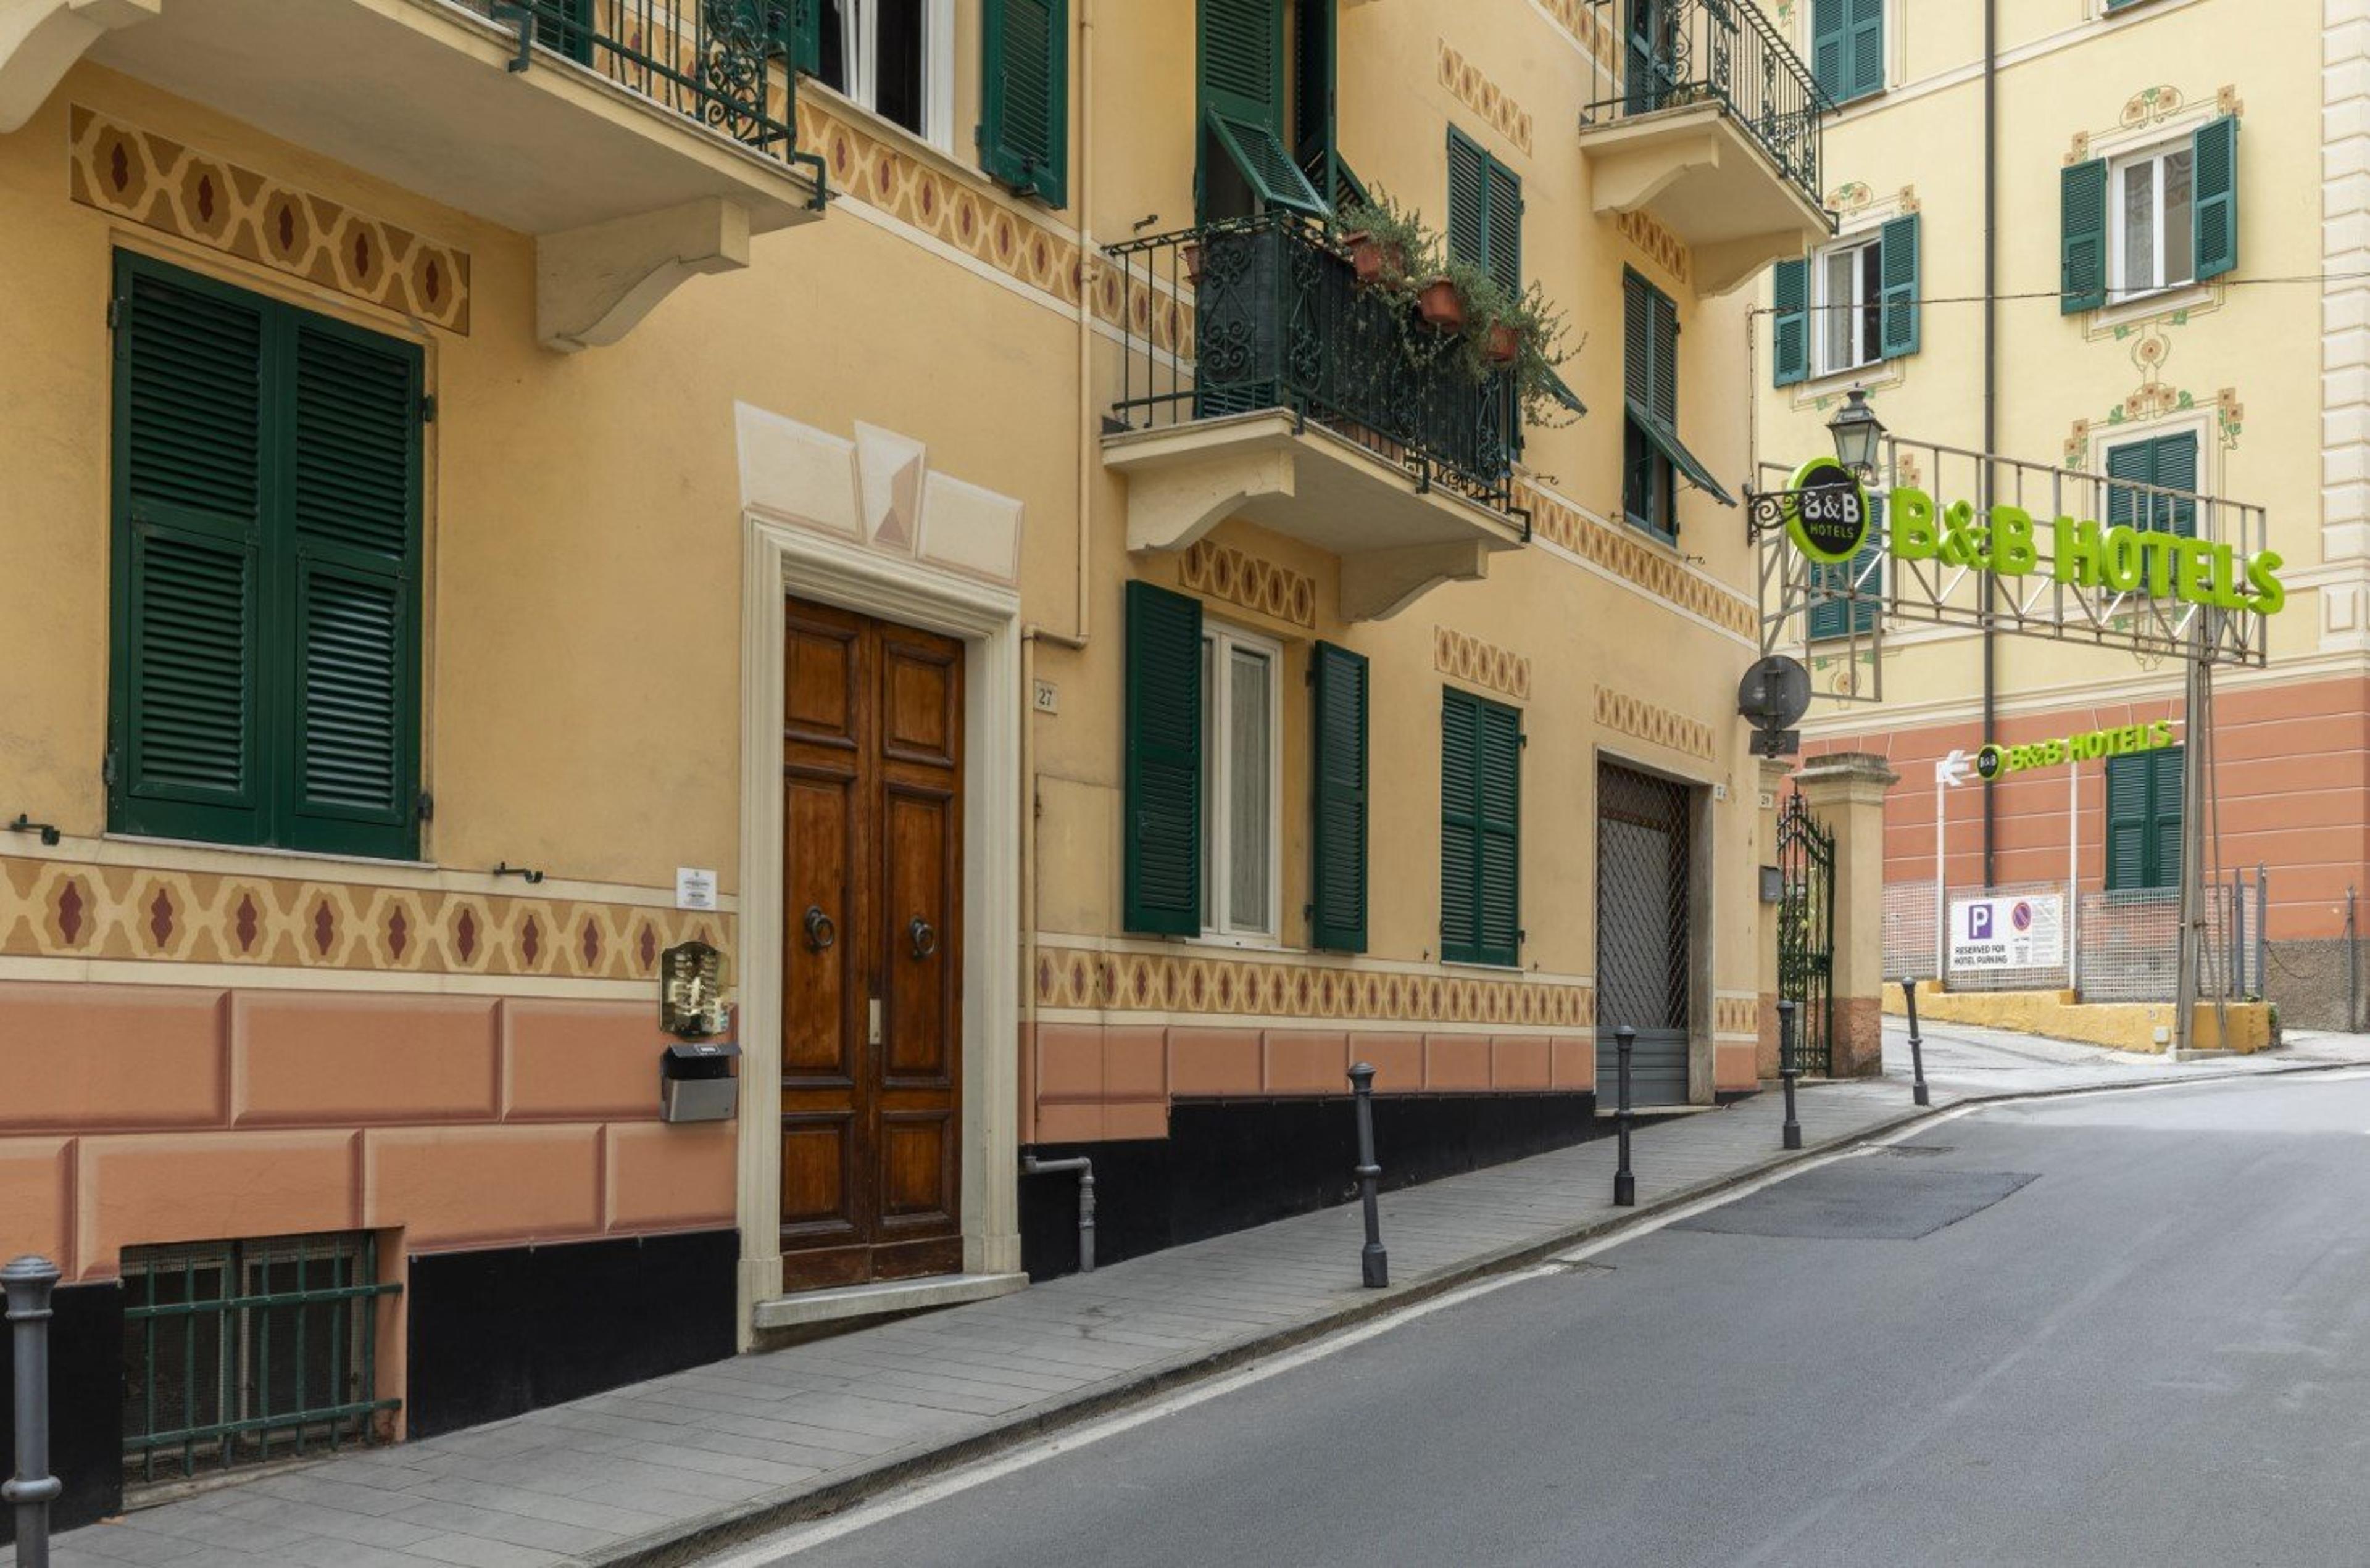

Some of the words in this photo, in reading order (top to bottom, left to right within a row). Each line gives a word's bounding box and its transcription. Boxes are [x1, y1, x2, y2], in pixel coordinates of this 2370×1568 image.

[1805, 491, 1860, 523] B&B
[1810, 524, 1855, 539] HOTELS
[1890, 486, 2039, 576] B&B
[2054, 515, 2285, 615] HOTELS
[1039, 687, 1052, 706] 27
[2010, 738, 2065, 771] B&B
[2069, 720, 2173, 763] HOTELS
[1973, 906, 1989, 937] P
[1954, 957, 1975, 966] HOTEL
[1977, 955, 2008, 965] PARKING
[1955, 945, 1990, 955] RESERVED
[1992, 945, 2005, 953] FOR
